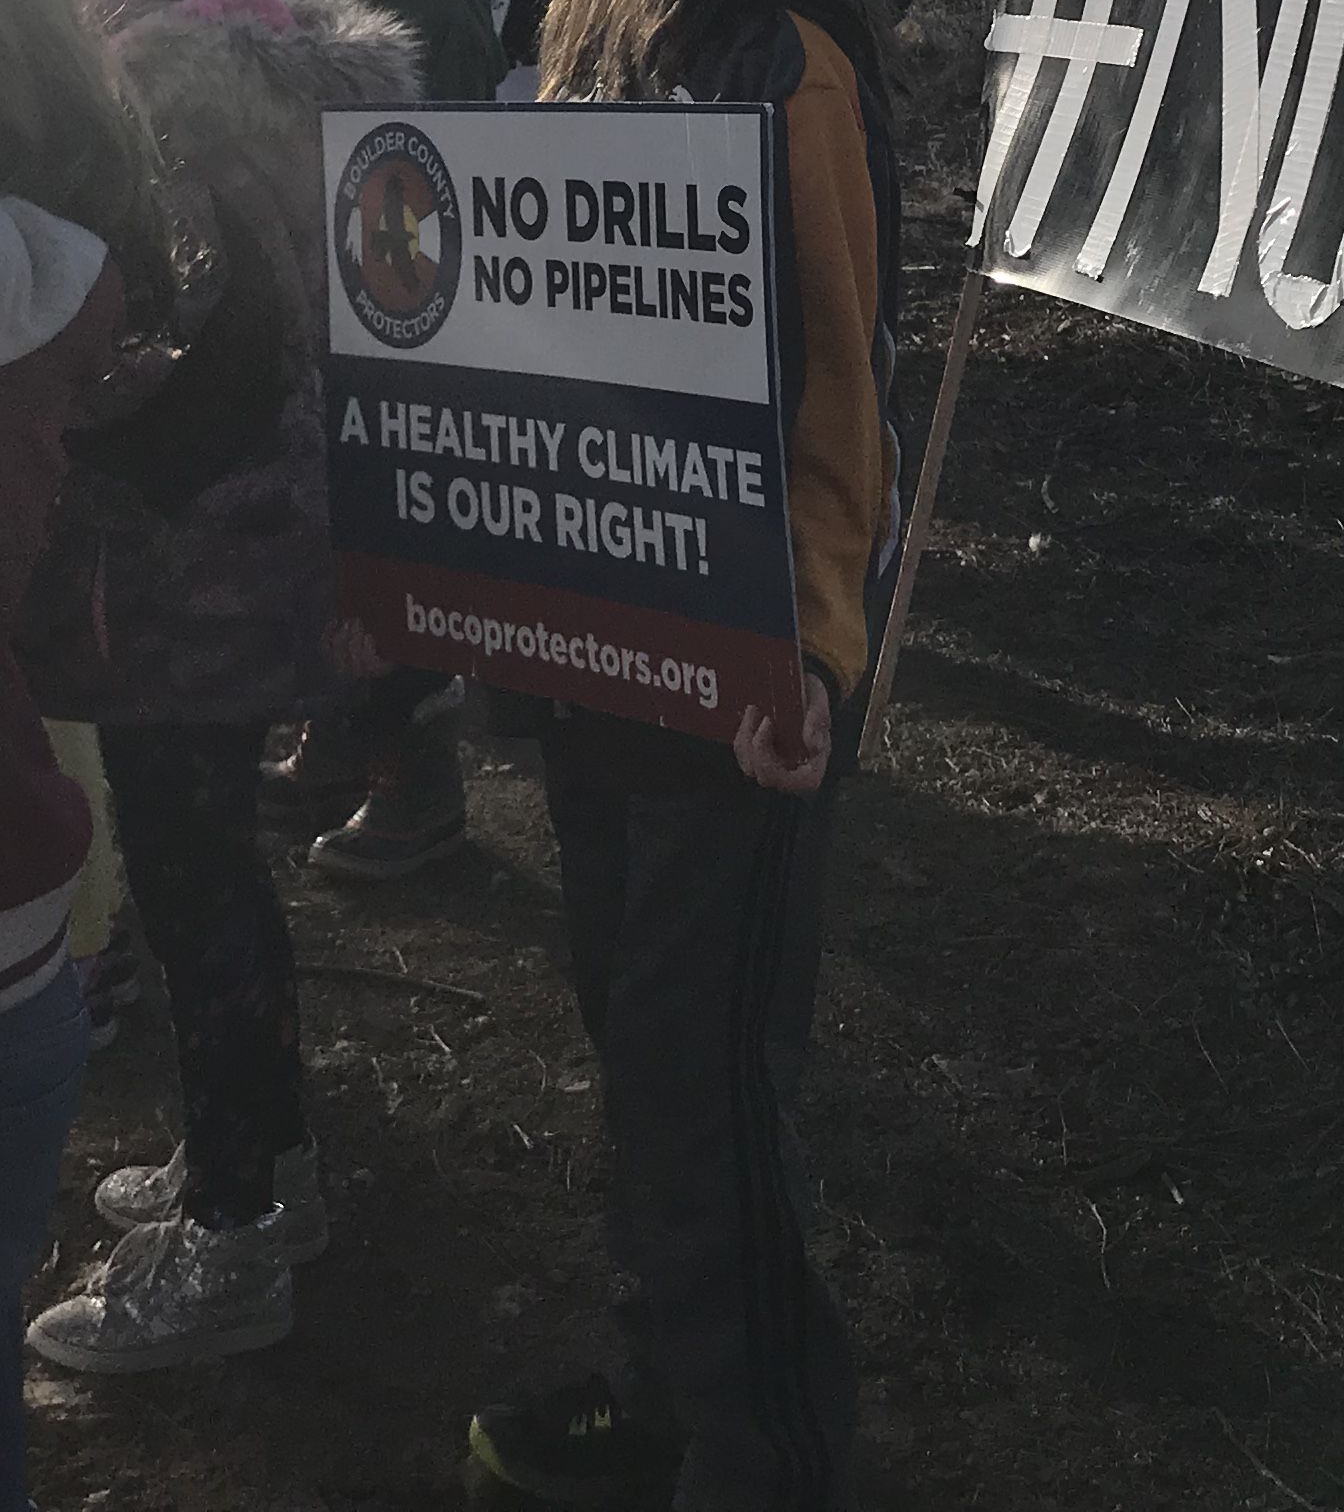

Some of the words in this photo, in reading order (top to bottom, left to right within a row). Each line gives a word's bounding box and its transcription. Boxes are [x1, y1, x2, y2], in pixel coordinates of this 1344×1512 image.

[343, 131, 405, 200] BOULDER
[408, 136, 455, 219] COUNTY
[471, 176, 549, 240] NO
[565, 178, 749, 255] DRILLS
[358, 289, 445, 339] PROTECTORS
[472, 254, 533, 306] NO
[546, 262, 754, 328] PIPELINES
[340, 396, 369, 446] A
[380, 400, 565, 472] HEALTHY
[577, 425, 765, 507] CLIMATE
[394, 469, 435, 523] IS
[447, 476, 543, 544] OUR
[556, 492, 709, 575] RIGHT!
[405, 592, 719, 710] bocoprotectors.org
